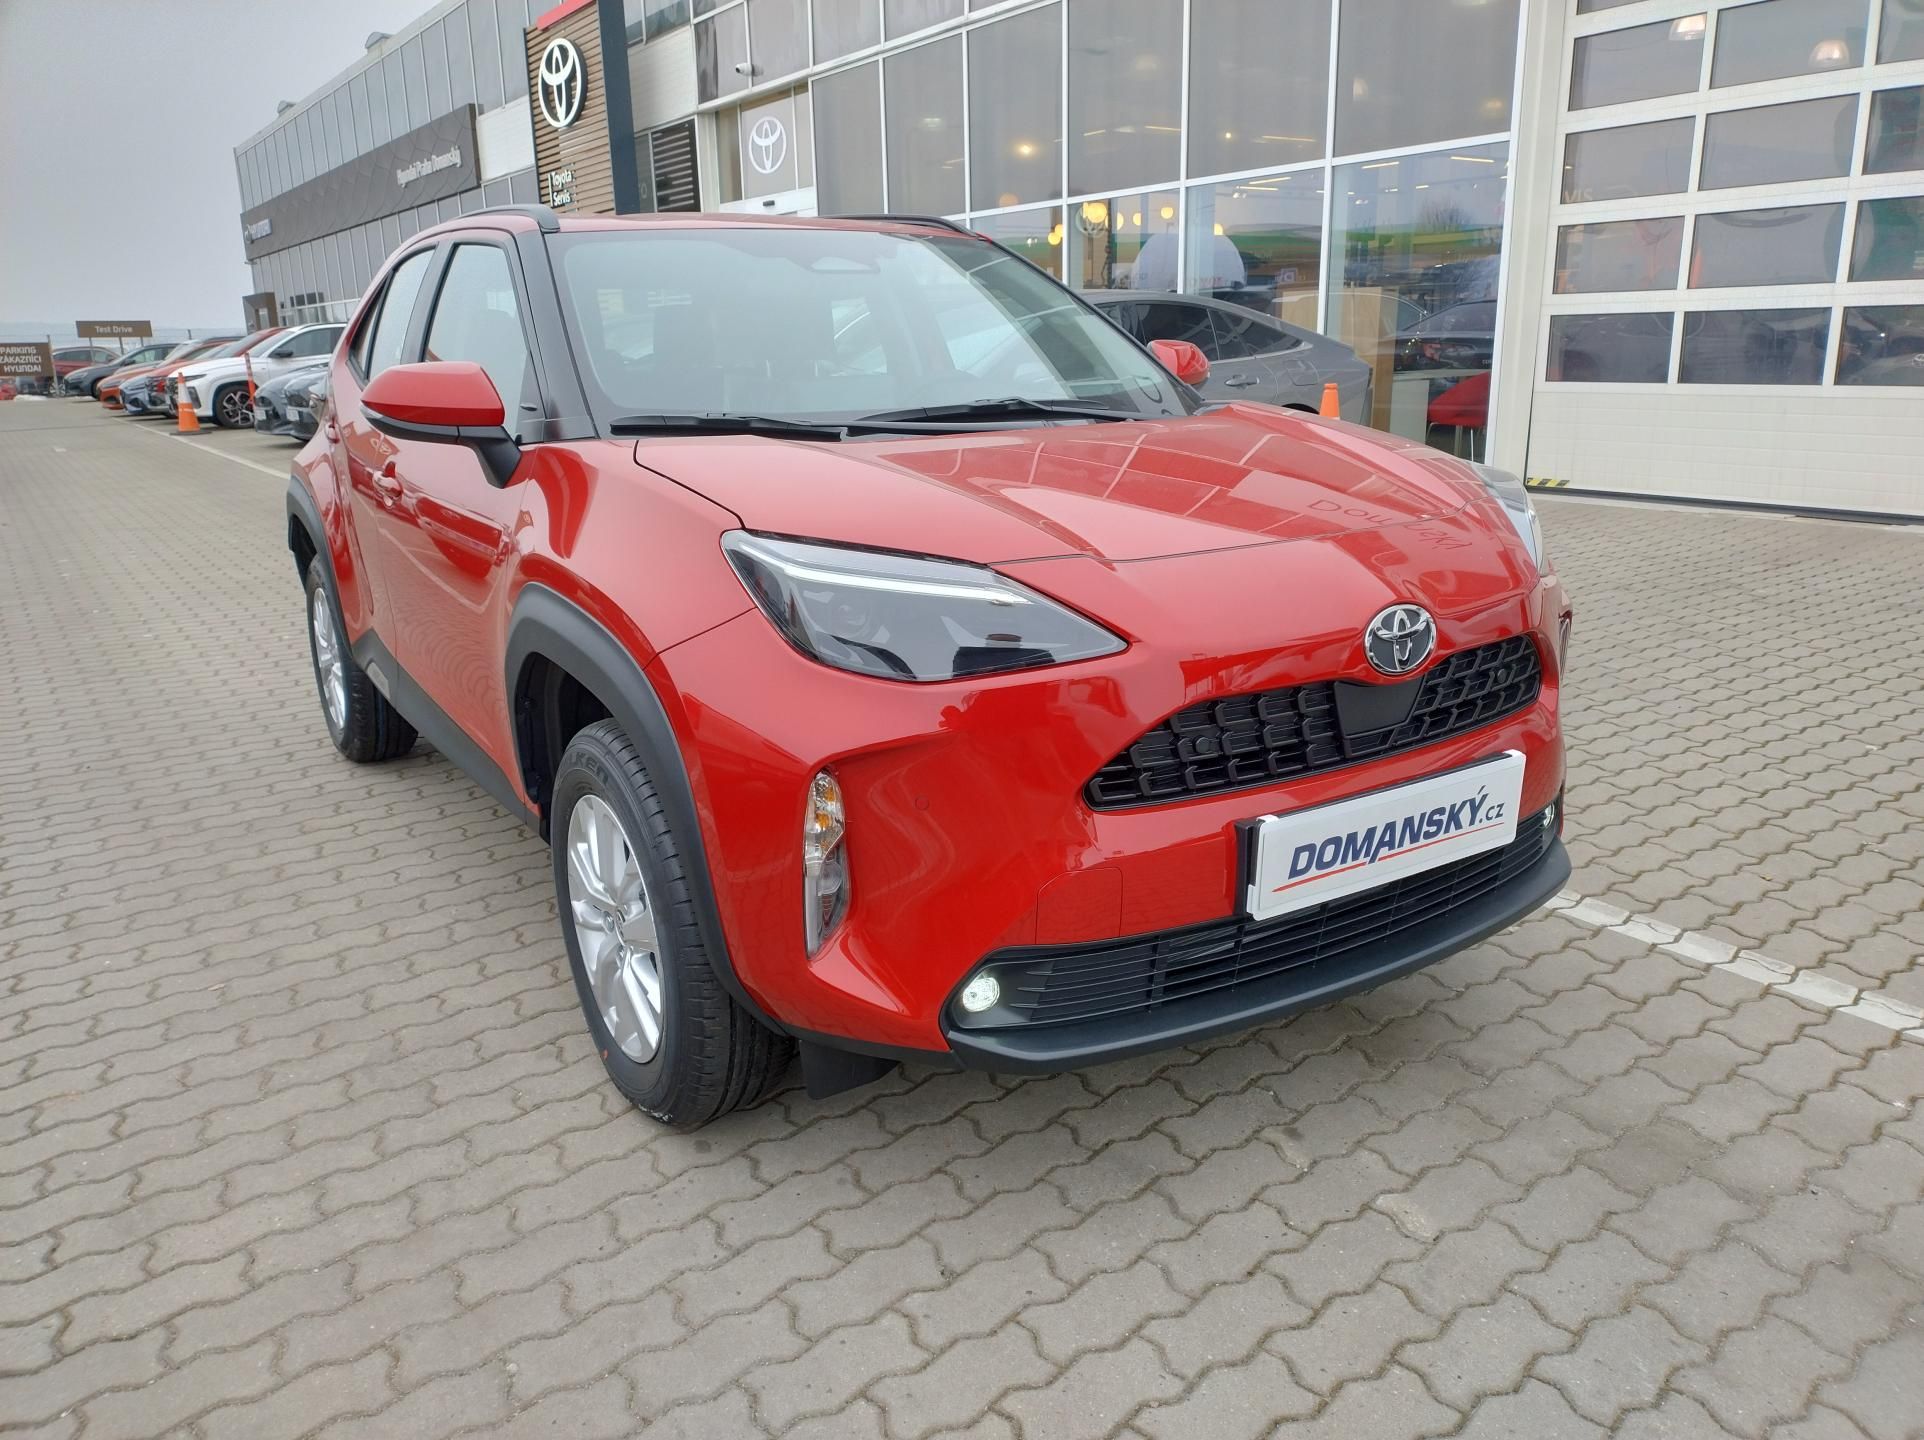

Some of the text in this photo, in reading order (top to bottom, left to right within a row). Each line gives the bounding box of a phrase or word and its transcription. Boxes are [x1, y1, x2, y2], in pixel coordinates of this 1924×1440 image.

[551, 169, 572, 188] Toyota
[553, 189, 571, 206] Servis
[95, 325, 133, 333] Test Drive
[0, 346, 37, 354] PARKING
[4, 364, 42, 373] HYUNDAI
